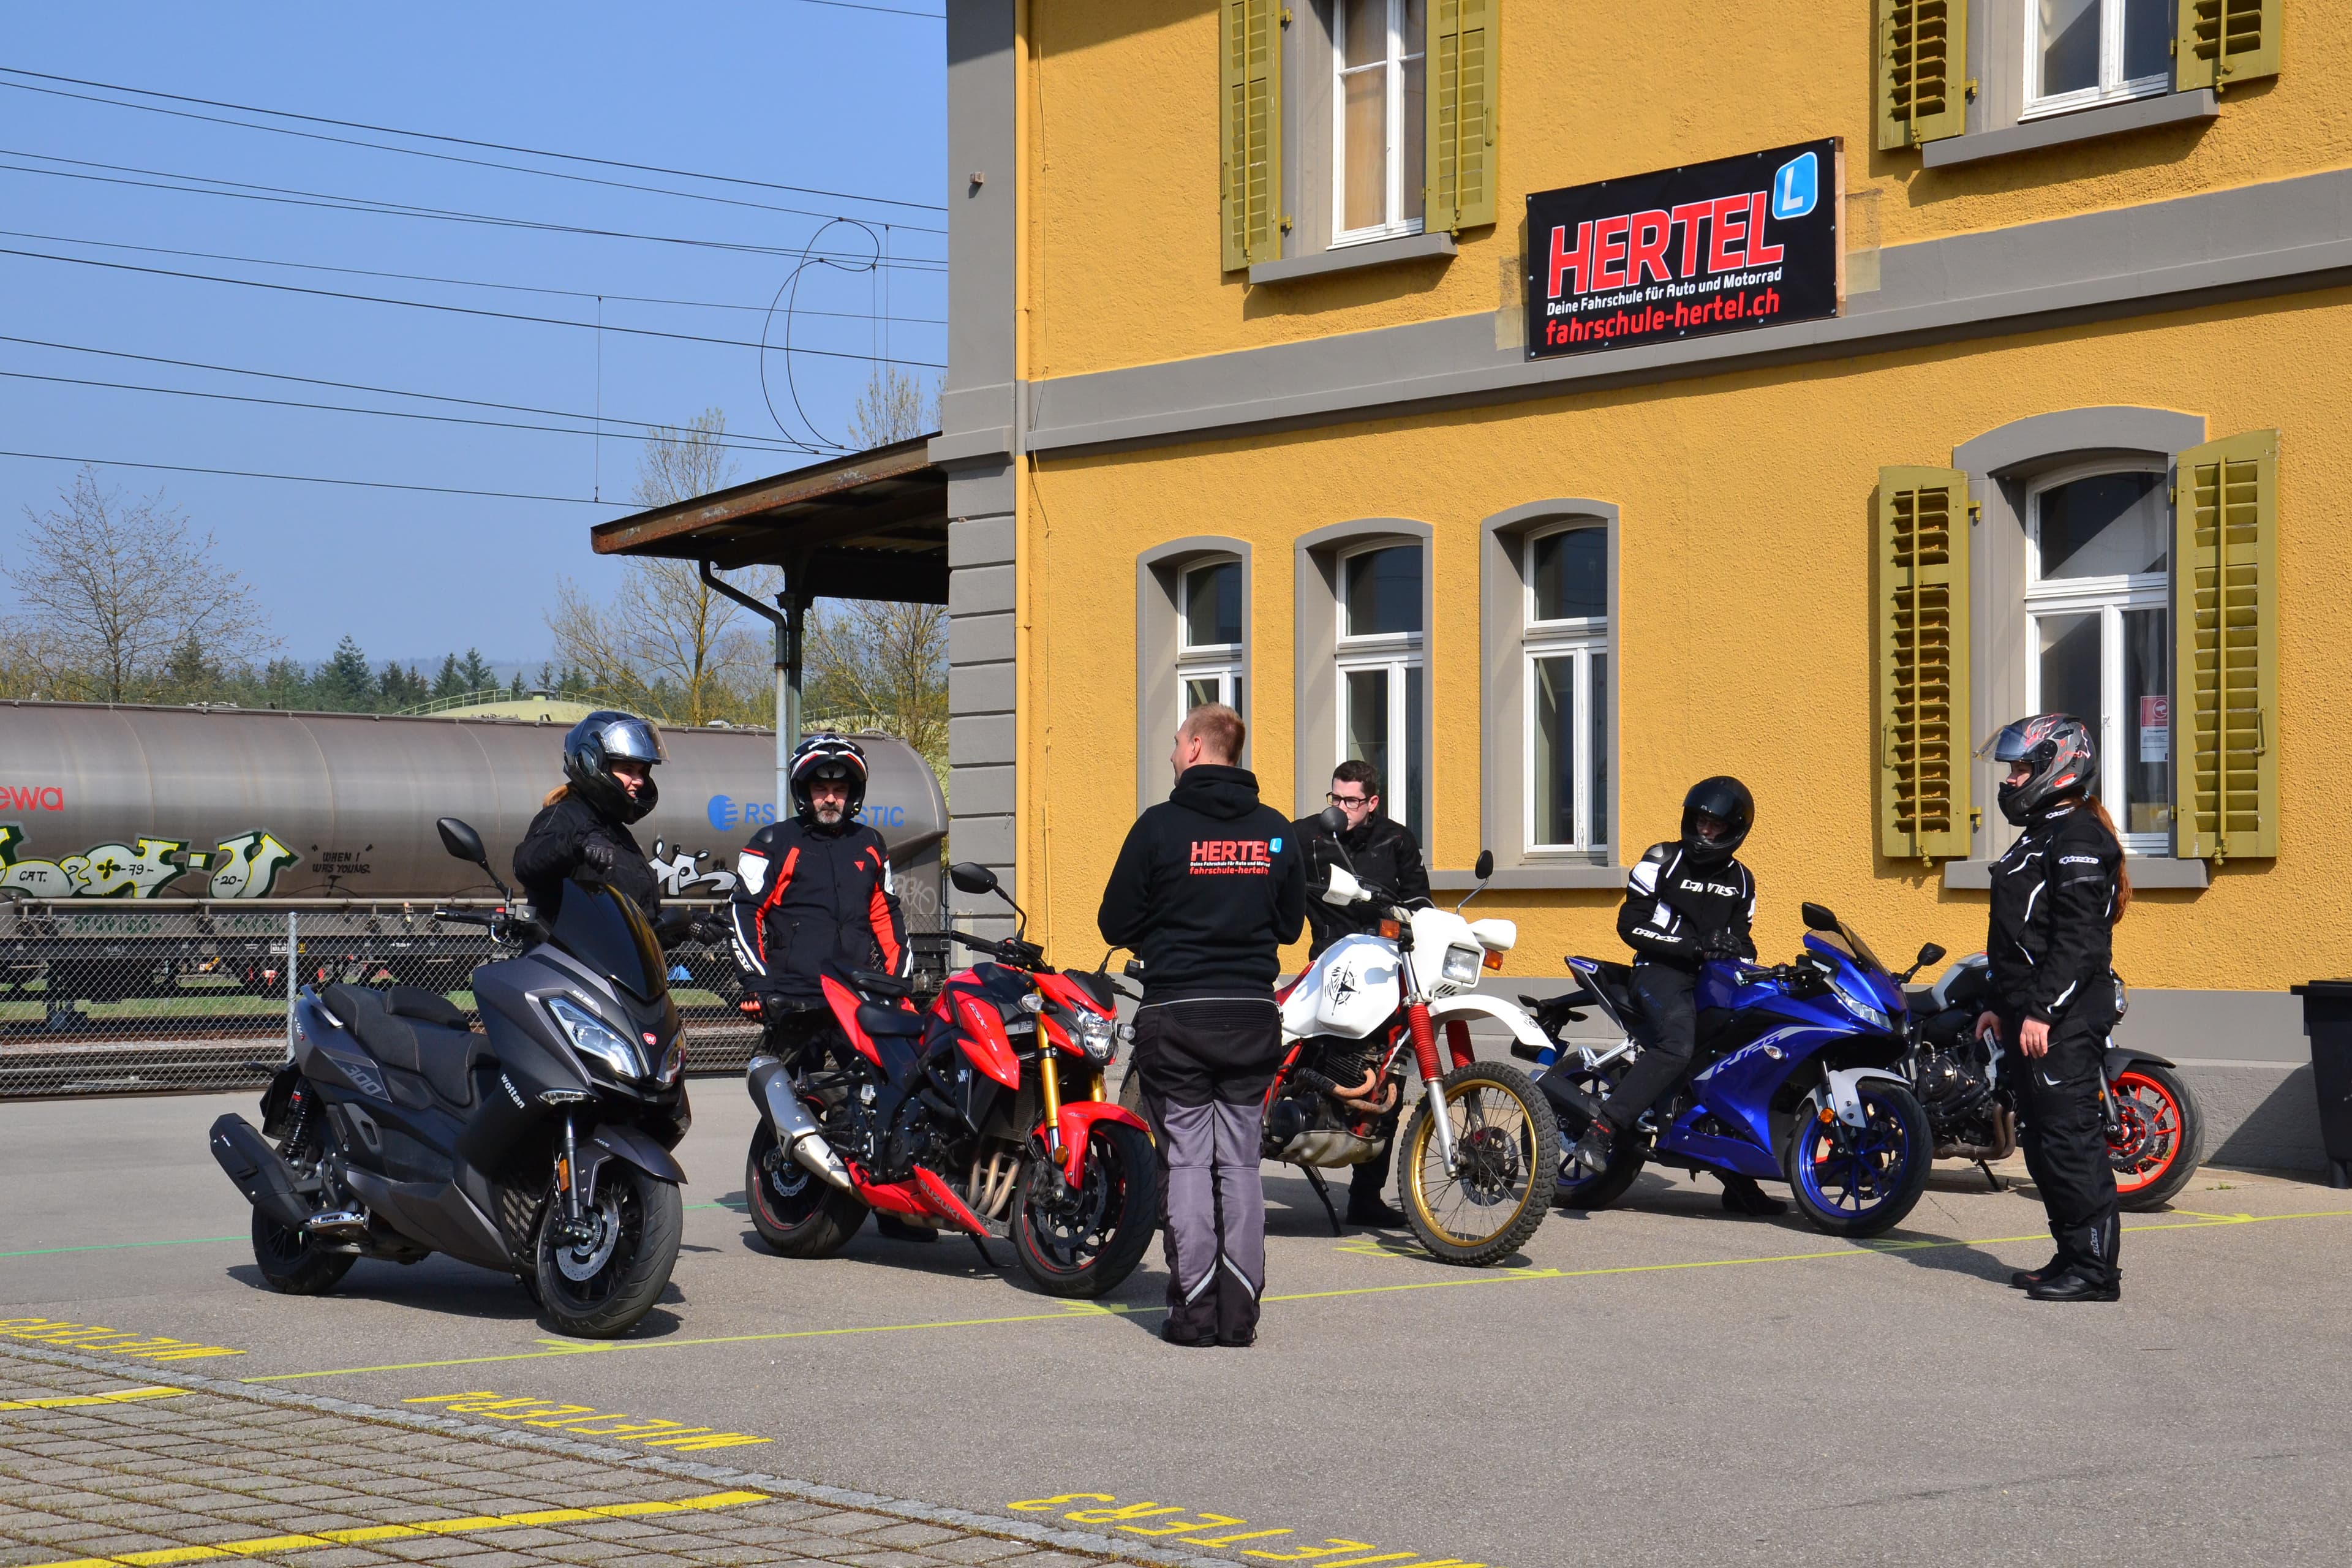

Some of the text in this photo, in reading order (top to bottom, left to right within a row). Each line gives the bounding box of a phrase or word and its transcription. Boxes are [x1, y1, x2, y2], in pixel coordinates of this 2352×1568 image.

[1782, 167, 1803, 211] L
[1547, 190, 1784, 298] HERTEL
[1547, 266, 1782, 315] Deine Fahrschule für Auto und Motorrad
[1545, 287, 1780, 345] fahrschule-hertel.ch
[323, 852, 351, 862] WHEN
[1191, 841, 1271, 862] HERTEL
[501, 1073, 525, 1109] wottan
[920, 1180, 960, 1220] SUZUKI
